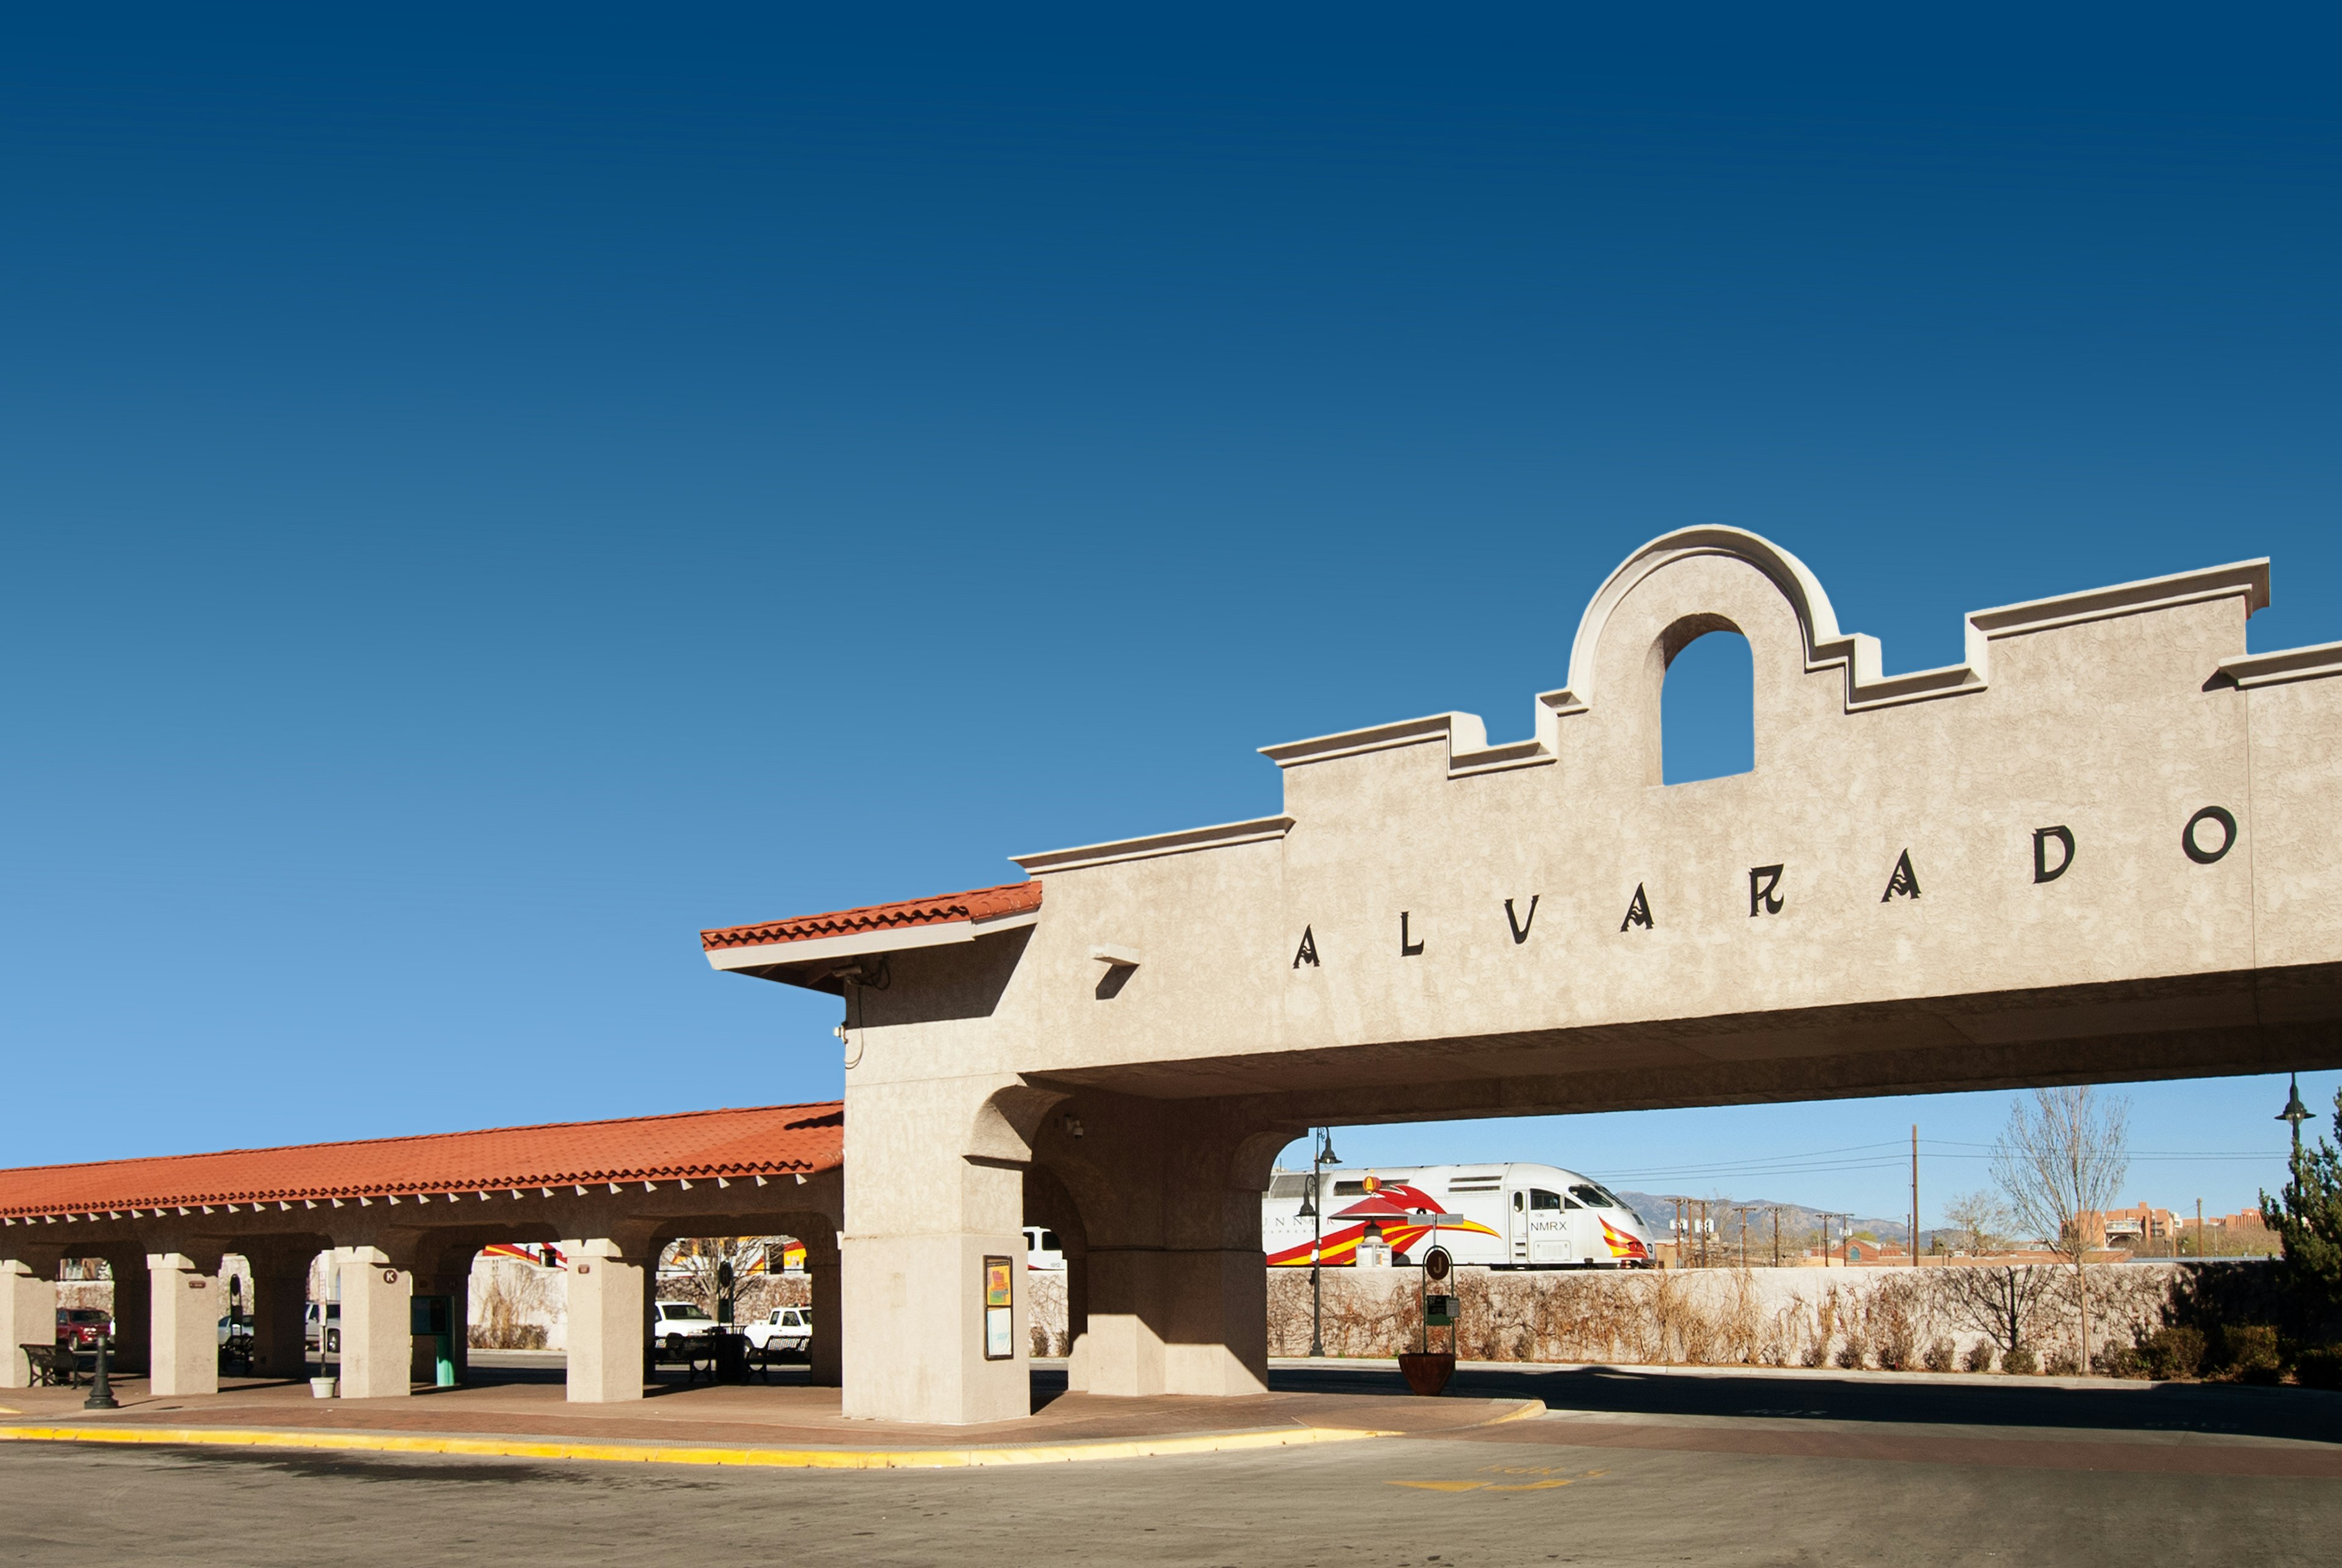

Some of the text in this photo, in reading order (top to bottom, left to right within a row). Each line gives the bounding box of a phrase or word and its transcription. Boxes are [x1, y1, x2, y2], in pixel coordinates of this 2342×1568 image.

[1292, 806, 2237, 970] ALVARADO
[1531, 1221, 1567, 1231] NMRX
[1433, 1256, 1442, 1273] J
[386, 1272, 395, 1281] K
